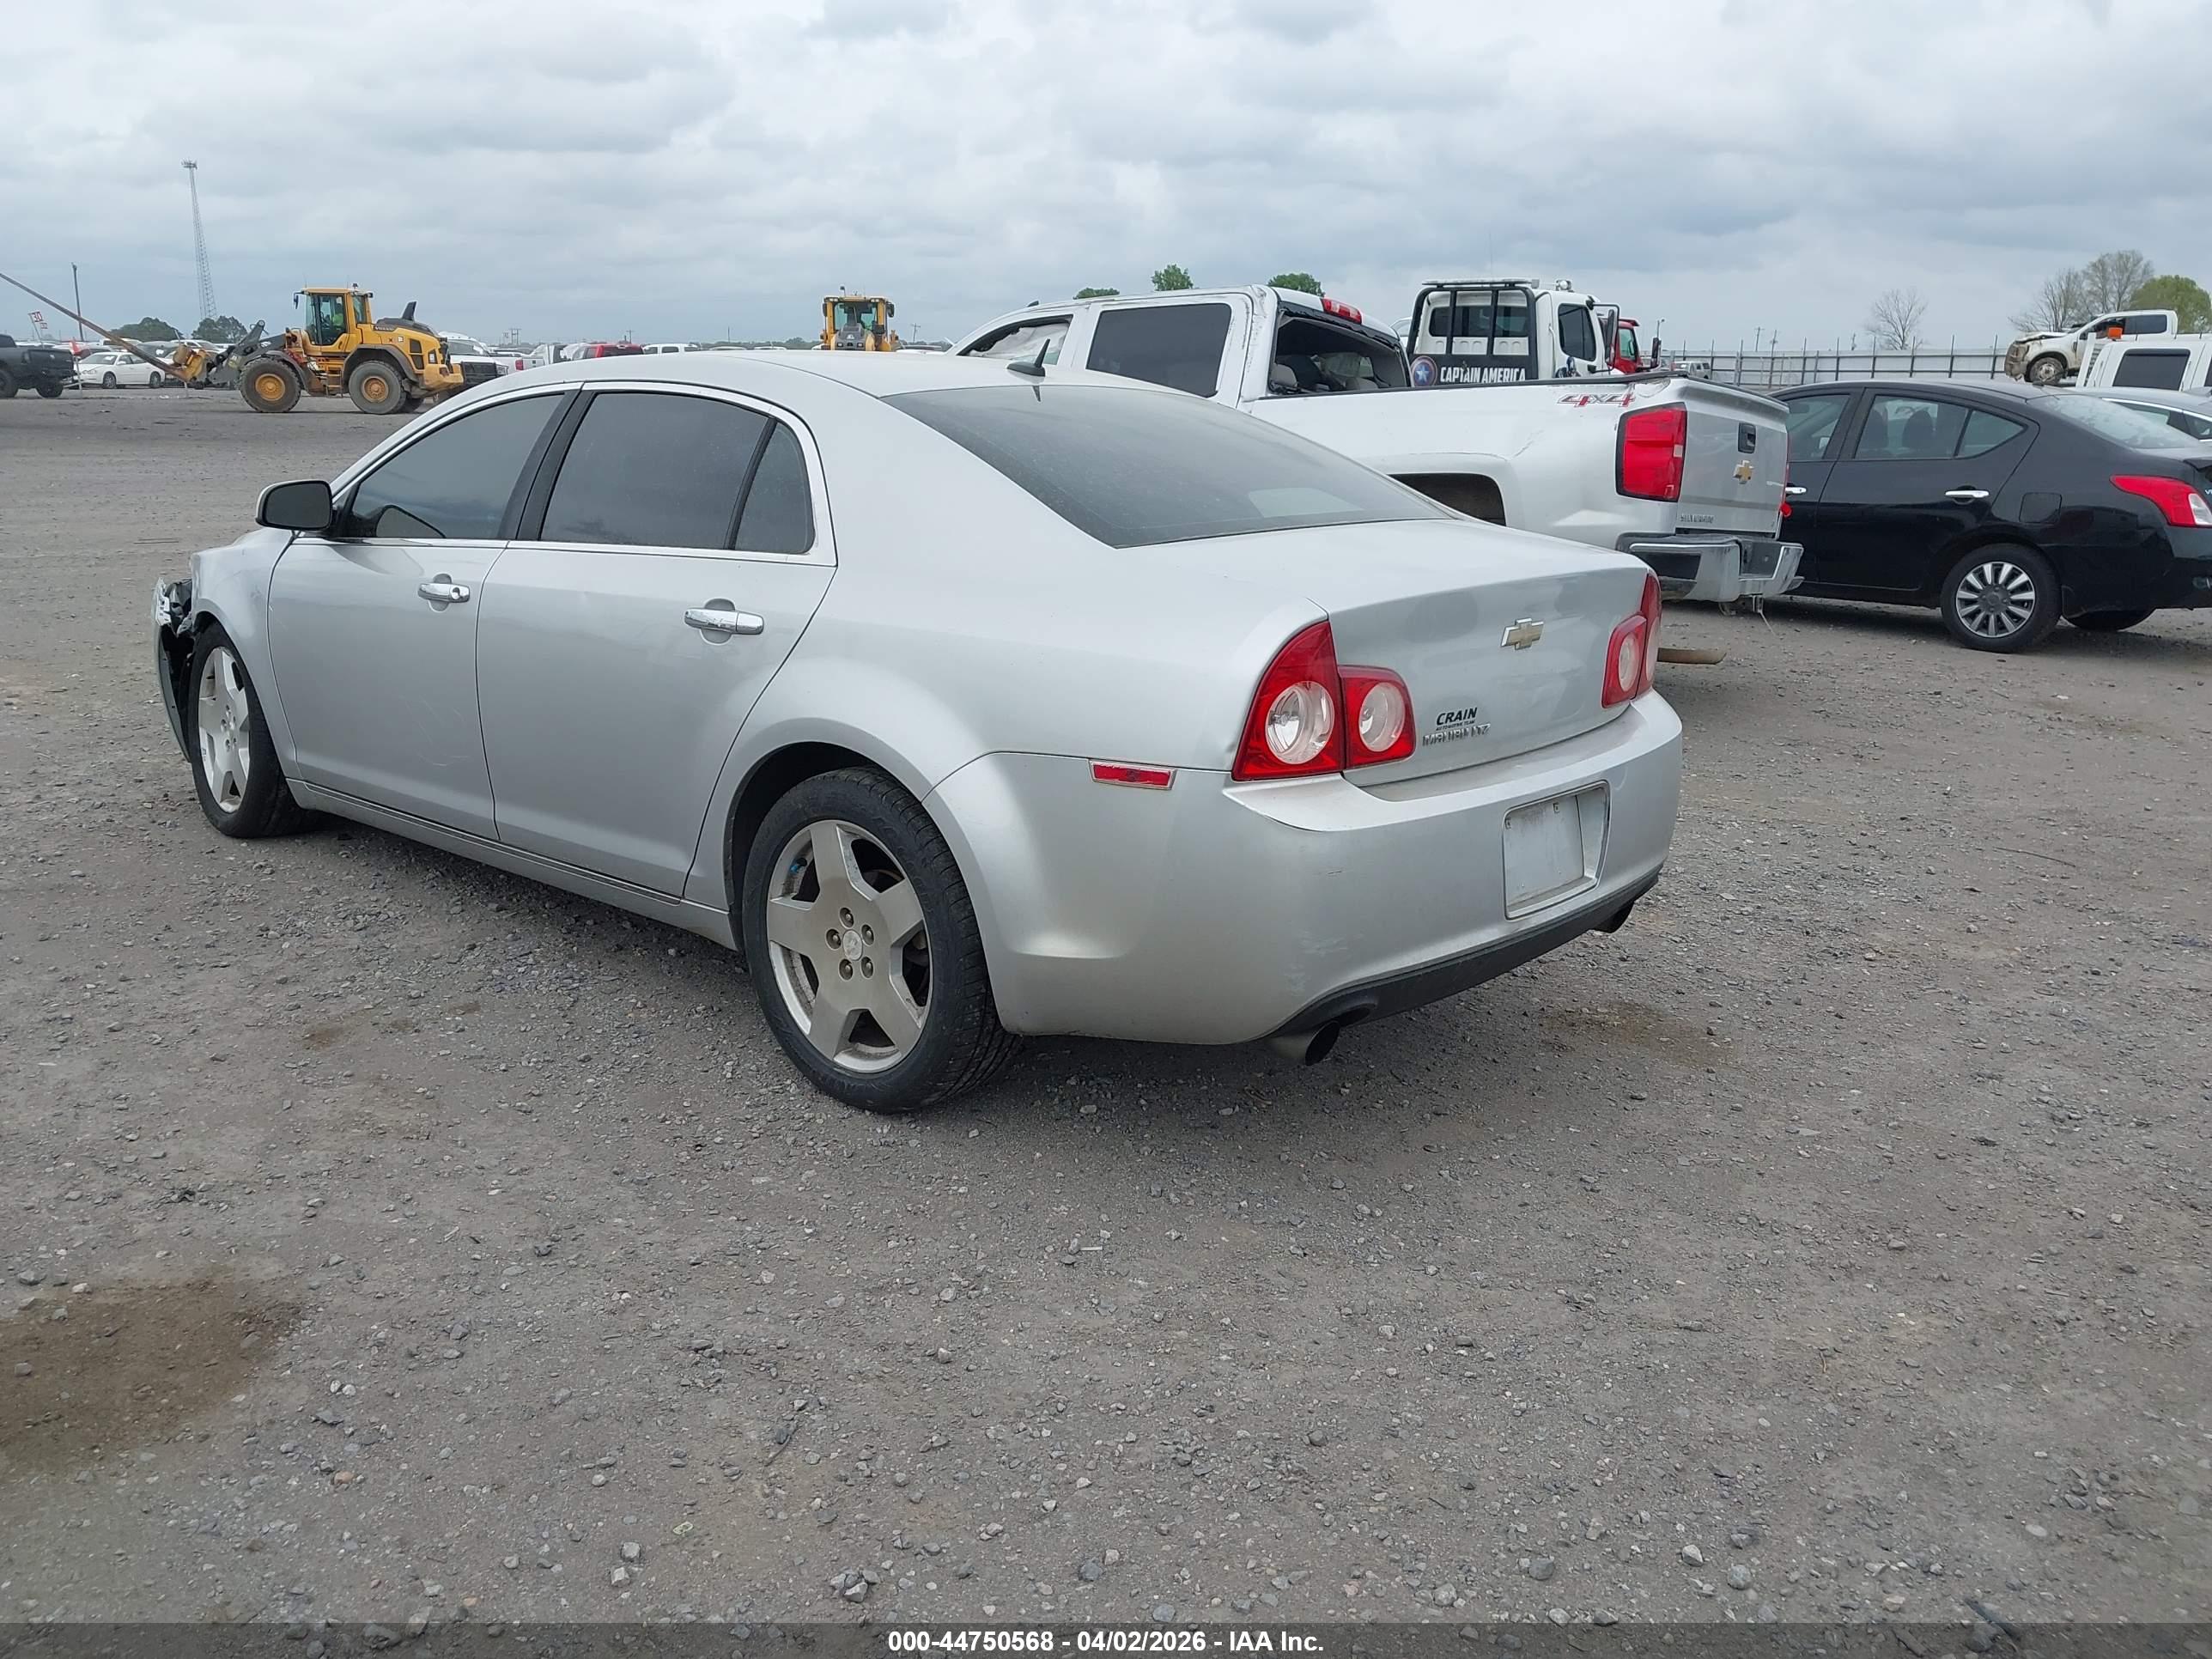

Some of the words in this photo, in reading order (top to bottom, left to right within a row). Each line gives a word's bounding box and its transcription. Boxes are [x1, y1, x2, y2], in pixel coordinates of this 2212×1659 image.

[1439, 366, 1481, 383] CAPTAIN
[1480, 367, 1527, 384] AMERICA
[1436, 707, 1478, 726] CRAIN
